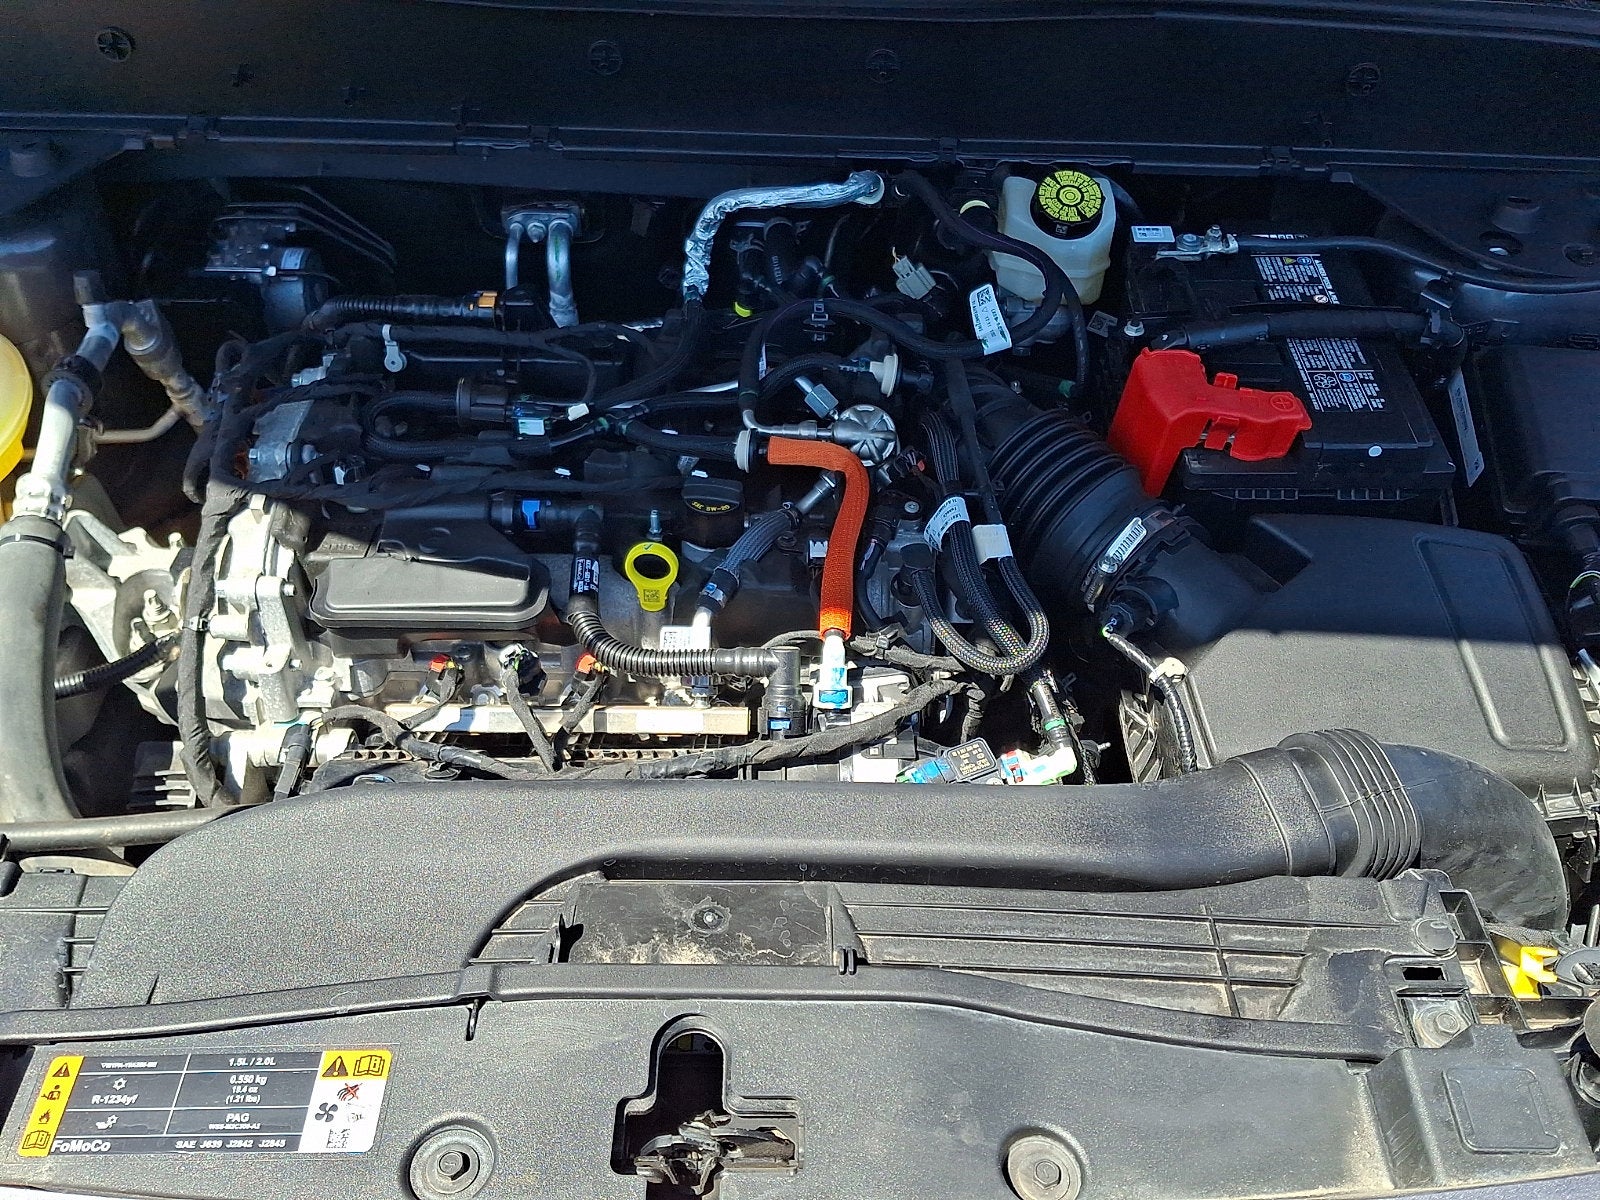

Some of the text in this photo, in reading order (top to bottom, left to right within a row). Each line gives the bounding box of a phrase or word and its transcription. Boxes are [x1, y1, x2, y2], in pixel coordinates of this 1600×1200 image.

[705, 504, 731, 512] 5W-20
[229, 1057, 249, 1066] 1.5L
[255, 1057, 277, 1066] 2.0L
[229, 1075, 268, 1086] 0.550 kg
[91, 1093, 139, 1106] R-1234yf
[225, 1112, 250, 1123] PAG
[50, 1139, 112, 1153] FoMoCo
[175, 1140, 197, 1149] SAE
